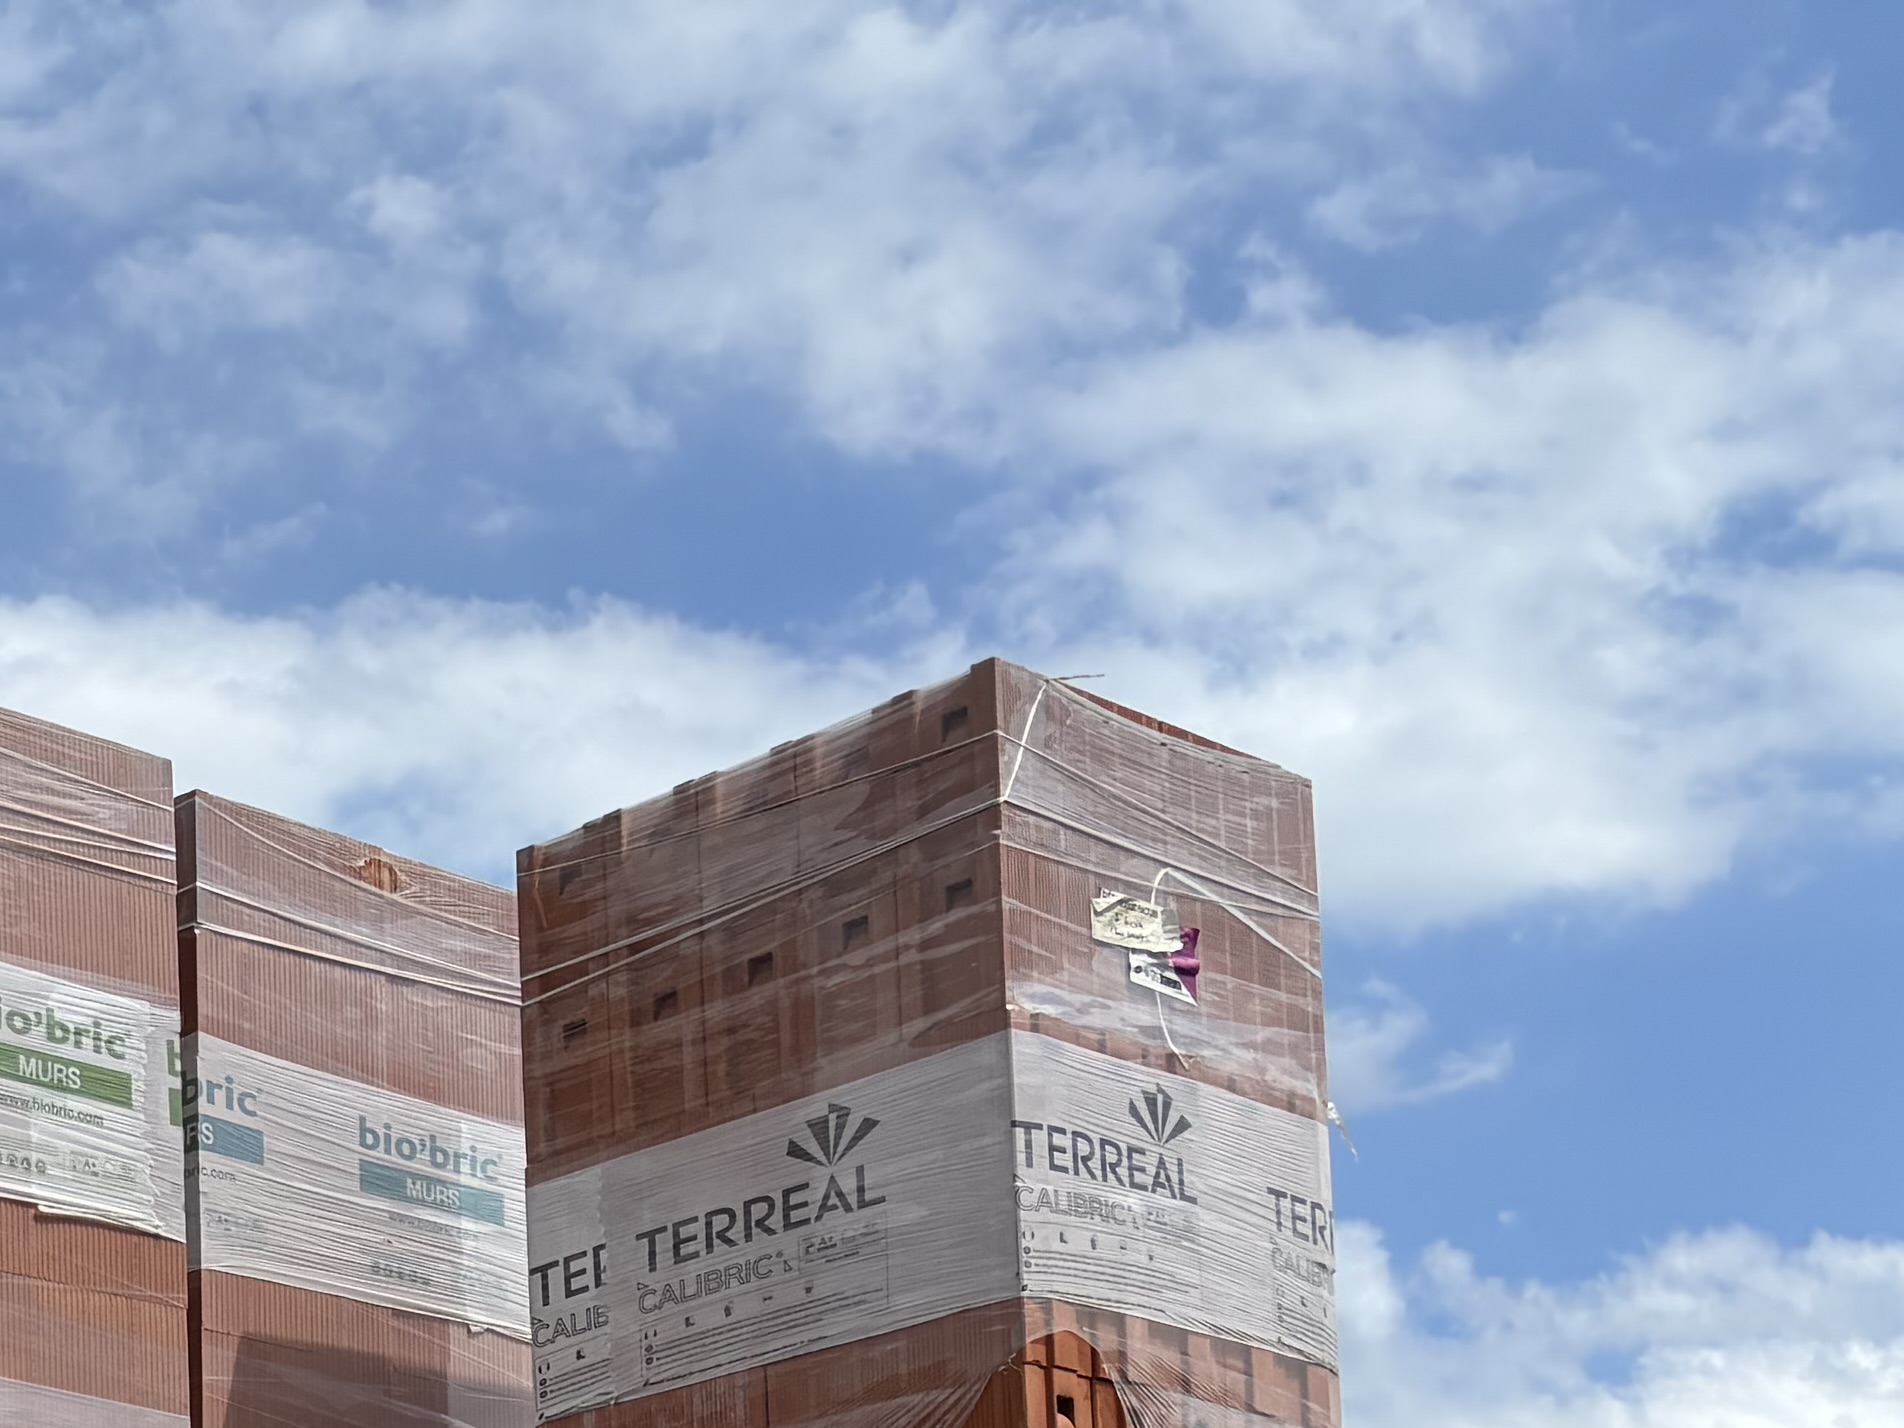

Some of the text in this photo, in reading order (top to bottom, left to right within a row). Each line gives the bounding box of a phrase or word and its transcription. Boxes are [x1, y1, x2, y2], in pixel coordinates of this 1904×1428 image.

[18, 1055, 82, 1090] MURS
[358, 1114, 499, 1183] bio'bric
[1010, 1119, 1198, 1205] TERREAL
[406, 1176, 461, 1209] MURS
[635, 1164, 887, 1273] TERREAL
